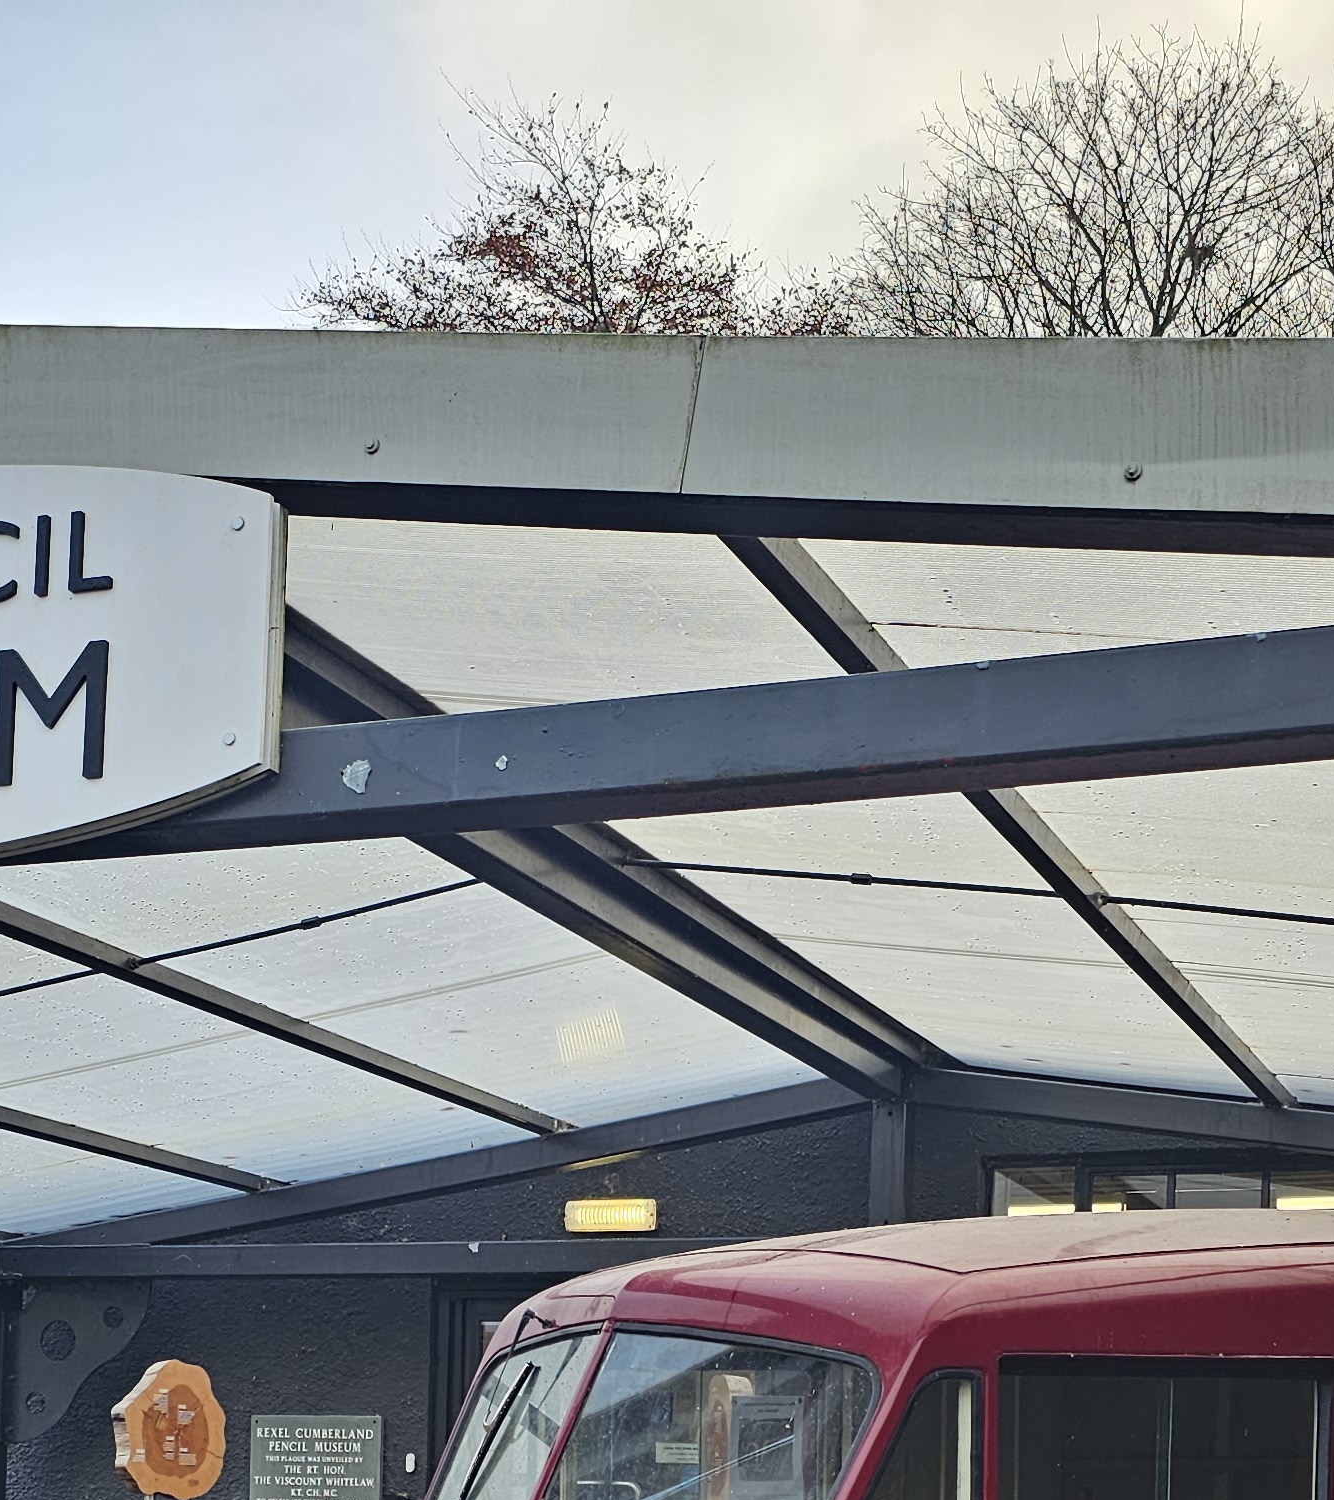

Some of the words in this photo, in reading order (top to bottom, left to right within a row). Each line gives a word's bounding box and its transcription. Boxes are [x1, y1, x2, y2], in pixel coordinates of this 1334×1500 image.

[257, 1427, 290, 1438] REXEL
[295, 1428, 374, 1440] CUMBERLAND
[269, 1440, 308, 1452] PENCIL
[314, 1441, 361, 1453] MUSEUM
[284, 1465, 302, 1474] THE
[254, 1476, 272, 1485] THE
[274, 1476, 322, 1486] VISCOUNT
